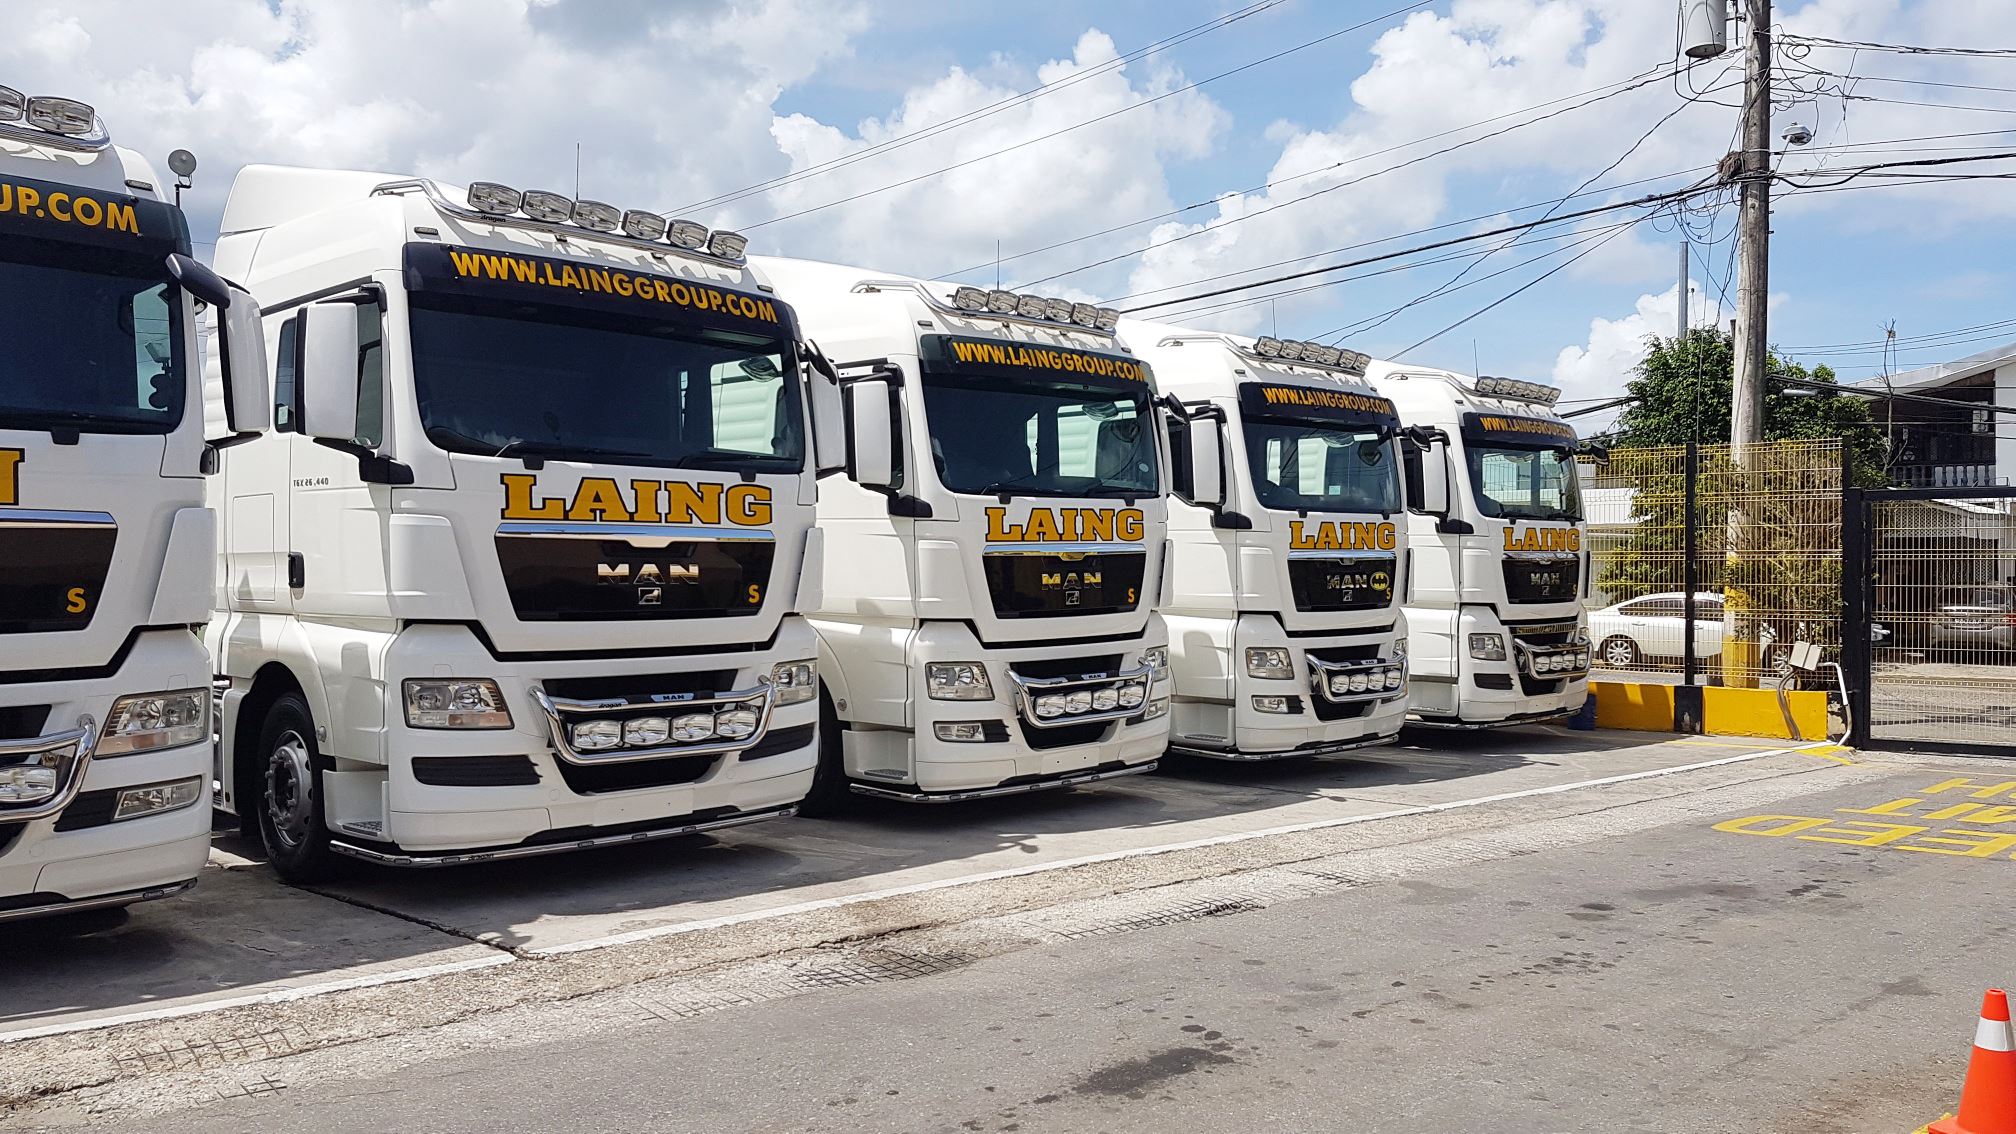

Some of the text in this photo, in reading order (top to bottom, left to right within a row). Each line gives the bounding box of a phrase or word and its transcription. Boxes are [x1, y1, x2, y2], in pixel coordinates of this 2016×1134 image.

[450, 251, 778, 323] WWW.LAINGGROUP.COM
[953, 342, 1146, 382] WWW.LAINGGROUP.COM
[1262, 387, 1392, 415] WWW.LAINGGROUP.COM
[500, 473, 773, 526] LAING
[985, 507, 1144, 542] LAING
[1289, 521, 1396, 550] LAING
[1503, 527, 1580, 552] LAING
[597, 563, 699, 585] MAN
[1041, 572, 1102, 590] MAN
[1326, 574, 1367, 589] MAN
[66, 587, 87, 613] S
[748, 585, 760, 603] S
[1127, 588, 1136, 603] S
[1386, 587, 1392, 600] S
